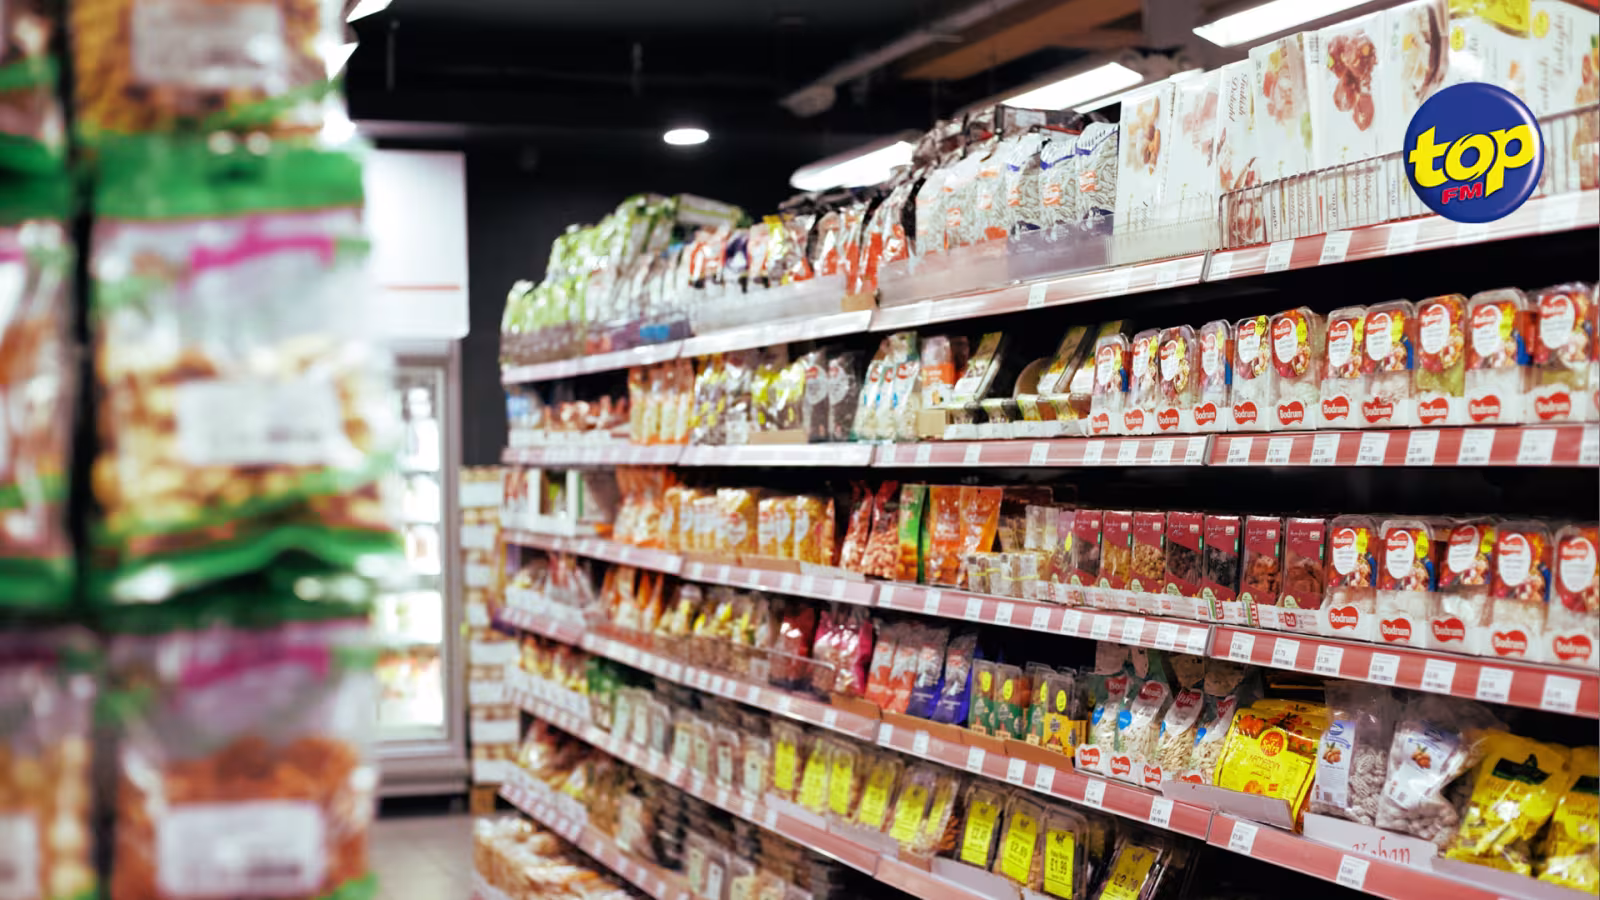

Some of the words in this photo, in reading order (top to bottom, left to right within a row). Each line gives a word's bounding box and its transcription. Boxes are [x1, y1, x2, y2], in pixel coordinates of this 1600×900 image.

[1228, 76, 1238, 122] Delight
[1239, 72, 1249, 116] Turkish
[1195, 409, 1216, 419] Bodrum
[1234, 408, 1257, 418] Bodrum
[1280, 407, 1303, 418] Bodrum
[1323, 403, 1347, 414] Bodrum
[1364, 405, 1392, 416] Bodrum
[1420, 404, 1447, 416] Bodrum
[1159, 415, 1178, 425] Bodrum
[1330, 612, 1357, 623] Bodrum
[1382, 623, 1410, 635] Bodrum
[1434, 623, 1463, 636] Bodrum
